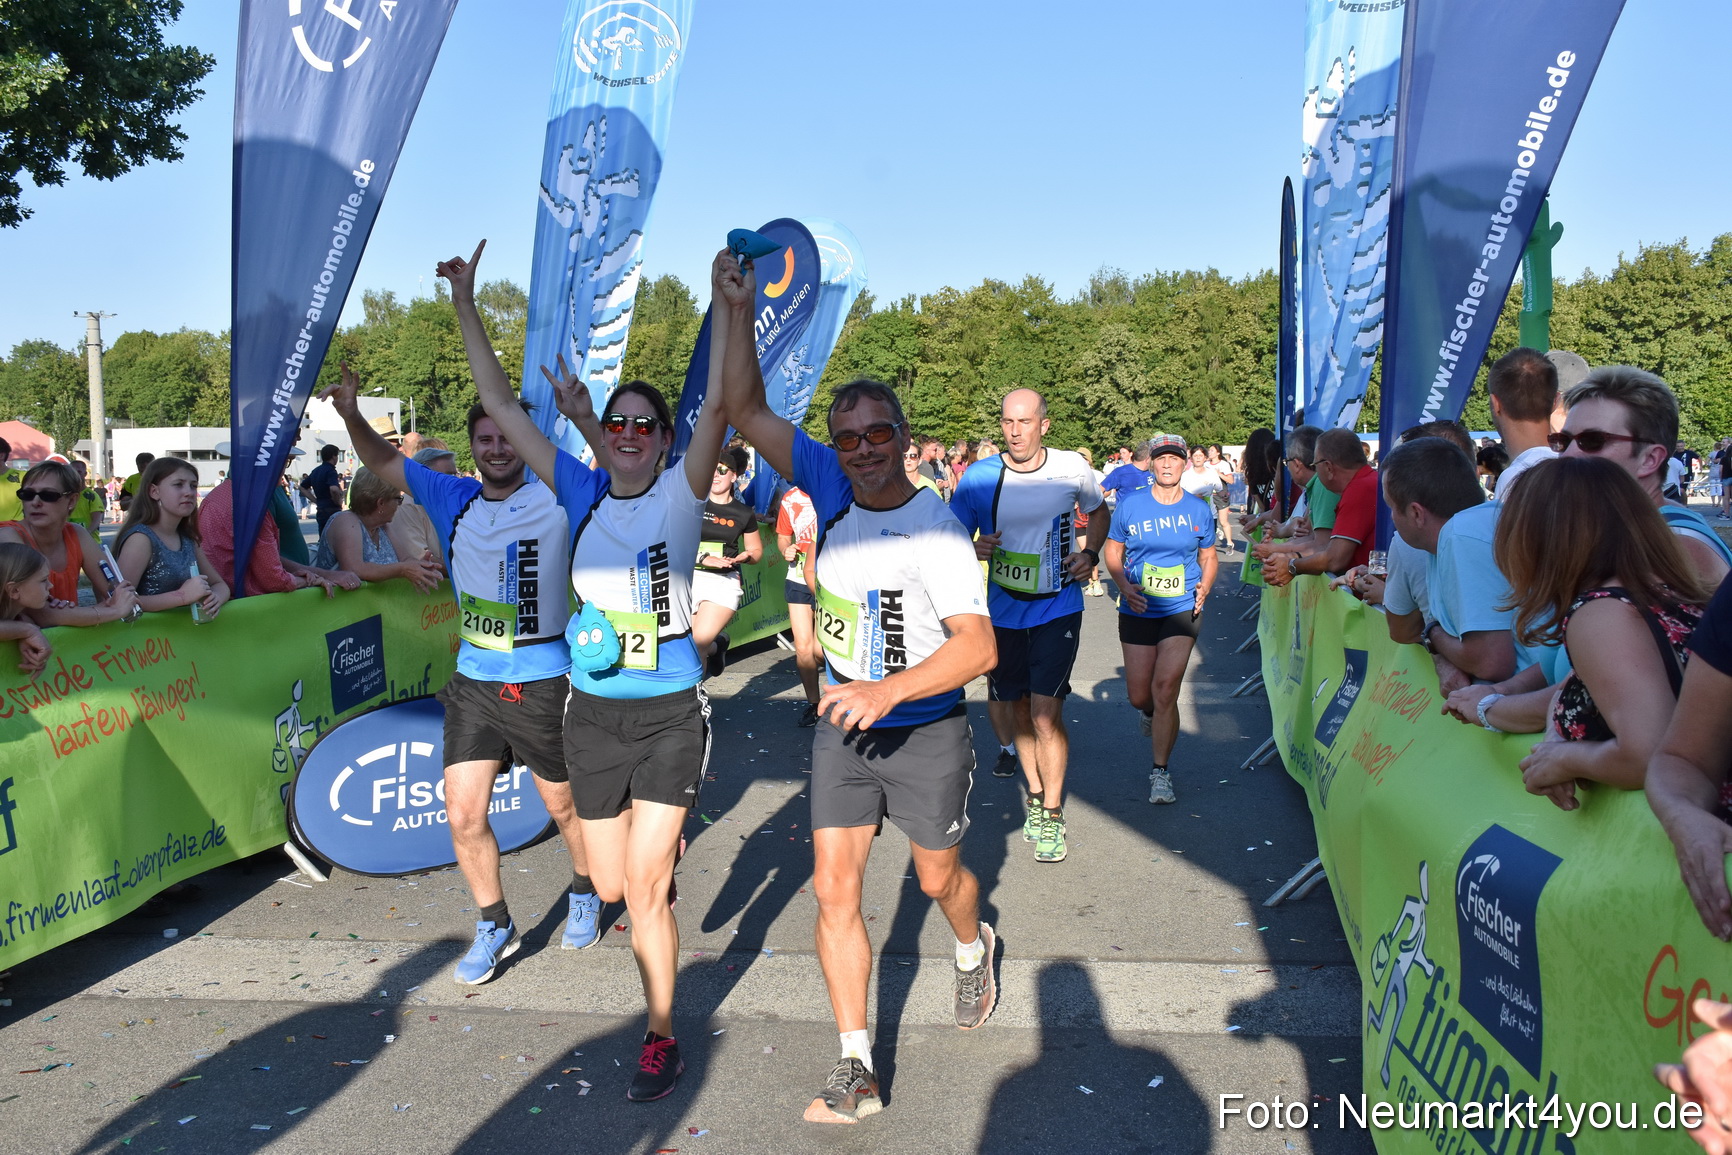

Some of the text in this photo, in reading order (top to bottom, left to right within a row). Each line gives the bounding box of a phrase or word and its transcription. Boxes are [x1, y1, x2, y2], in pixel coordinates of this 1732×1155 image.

[593, 49, 679, 88] WECHSELSZENE
[254, 158, 375, 467] www.fischer-automobile.de
[765, 320, 781, 346] und
[780, 283, 811, 325] Medien
[518, 539, 539, 636] HUBER
[995, 560, 1031, 582] 2101
[1147, 576, 1180, 589] 1730
[463, 610, 506, 638] 2108
[340, 644, 375, 669] Fischer
[344, 657, 375, 676] AUTOMOBILE
[45, 661, 206, 759] laufen länger!
[372, 765, 528, 814] Fiscer
[392, 796, 521, 832] AUTOBILE
[1467, 880, 1522, 948] Fischer
[1473, 924, 1520, 971] AUTOMOBILE
